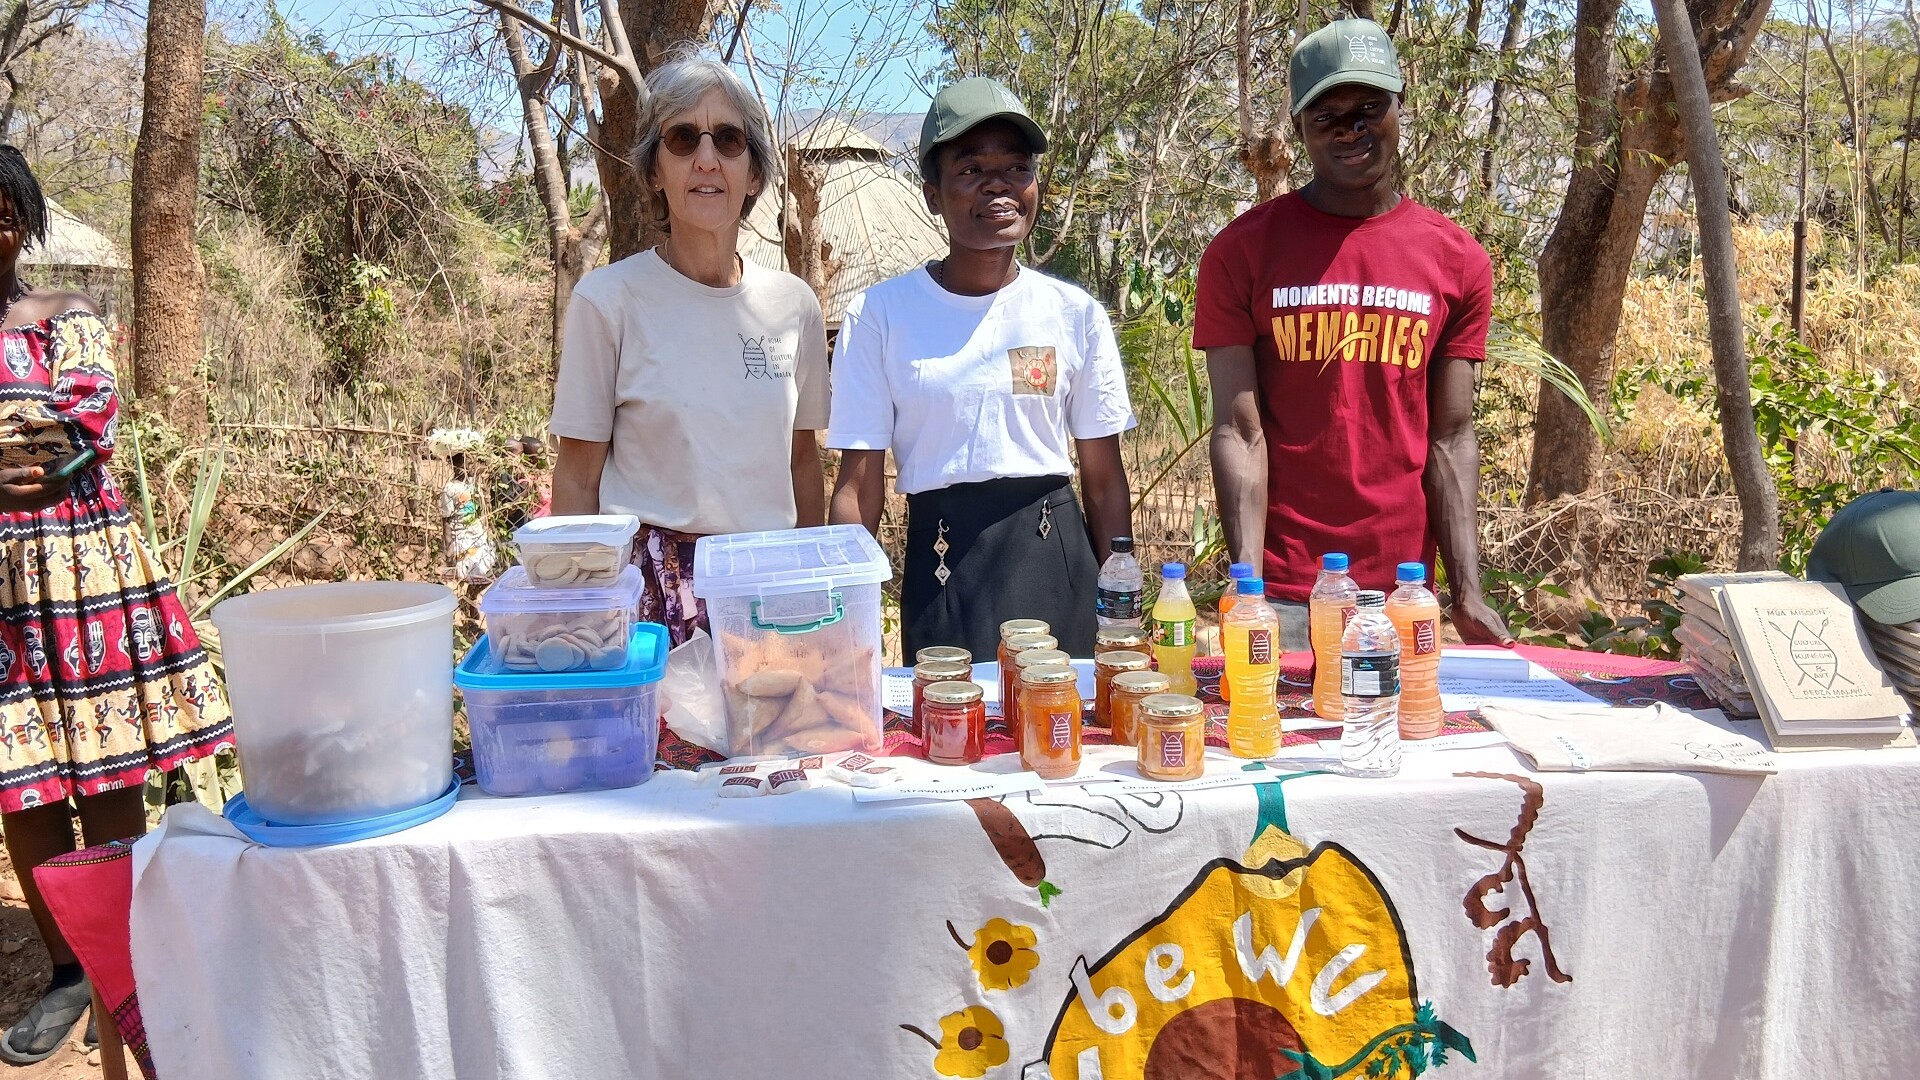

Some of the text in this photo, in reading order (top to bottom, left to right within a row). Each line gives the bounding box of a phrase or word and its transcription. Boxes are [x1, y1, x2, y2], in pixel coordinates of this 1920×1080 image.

[1272, 284, 1431, 315] MOMENTS BECOME
[1271, 311, 1429, 370] MEMORIES
[1790, 608, 1826, 616] MISSION
[1802, 687, 1863, 696] DEDZA MALAWI
